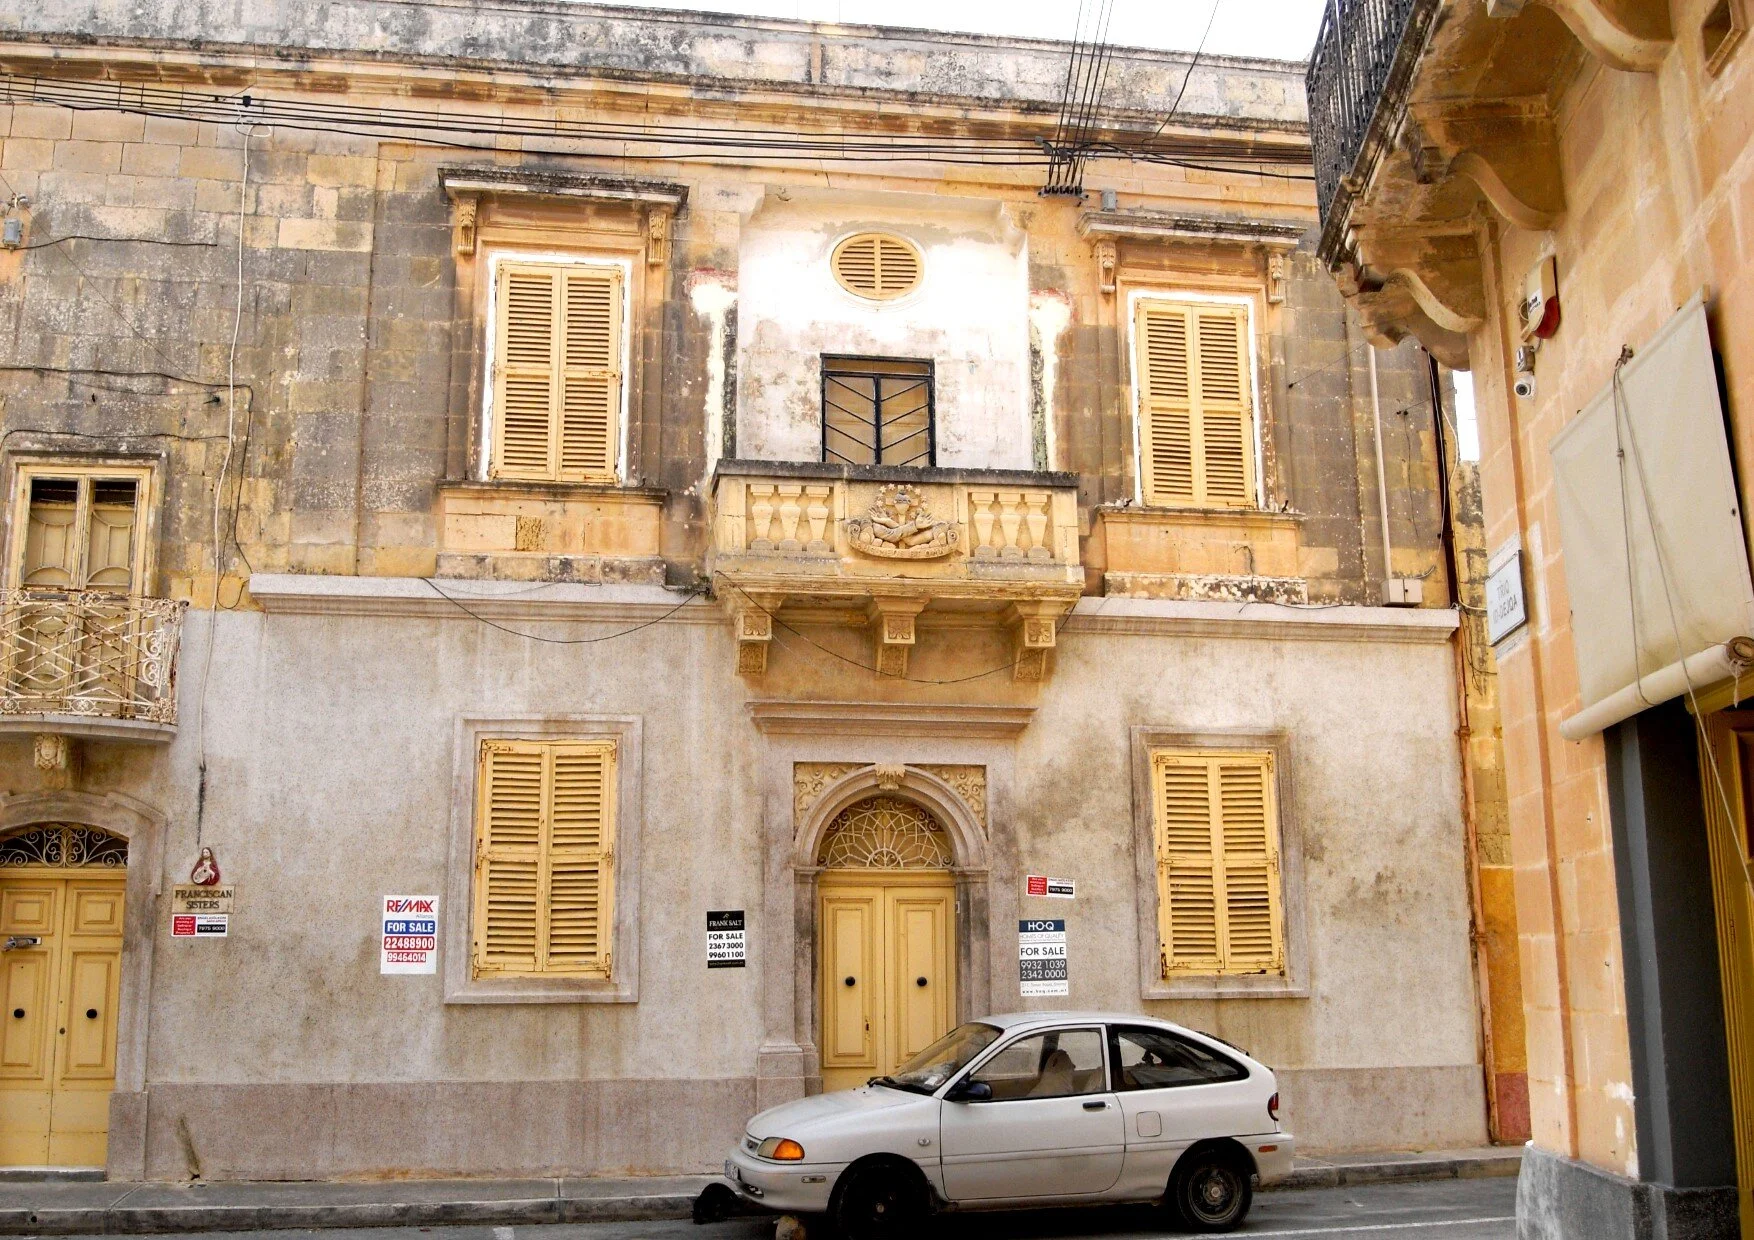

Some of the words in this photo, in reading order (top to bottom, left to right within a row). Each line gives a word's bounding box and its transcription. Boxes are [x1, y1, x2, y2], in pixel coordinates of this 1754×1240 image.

[175, 889, 232, 899] FRANCISCAN
[186, 900, 220, 909] SISTERS
[387, 899, 434, 913] RE/MAX
[387, 922, 406, 932] FOR
[409, 922, 434, 932] SALE
[726, 932, 743, 940] SALE
[385, 937, 434, 949] 22488900
[1020, 947, 1040, 956] FOR
[1042, 946, 1065, 956] SALE
[388, 952, 426, 962] 99464014
[1021, 961, 1042, 969] 9932
[1045, 960, 1066, 969] 1039
[1021, 970, 1043, 979] 2342
[1044, 969, 1066, 978] 0000
